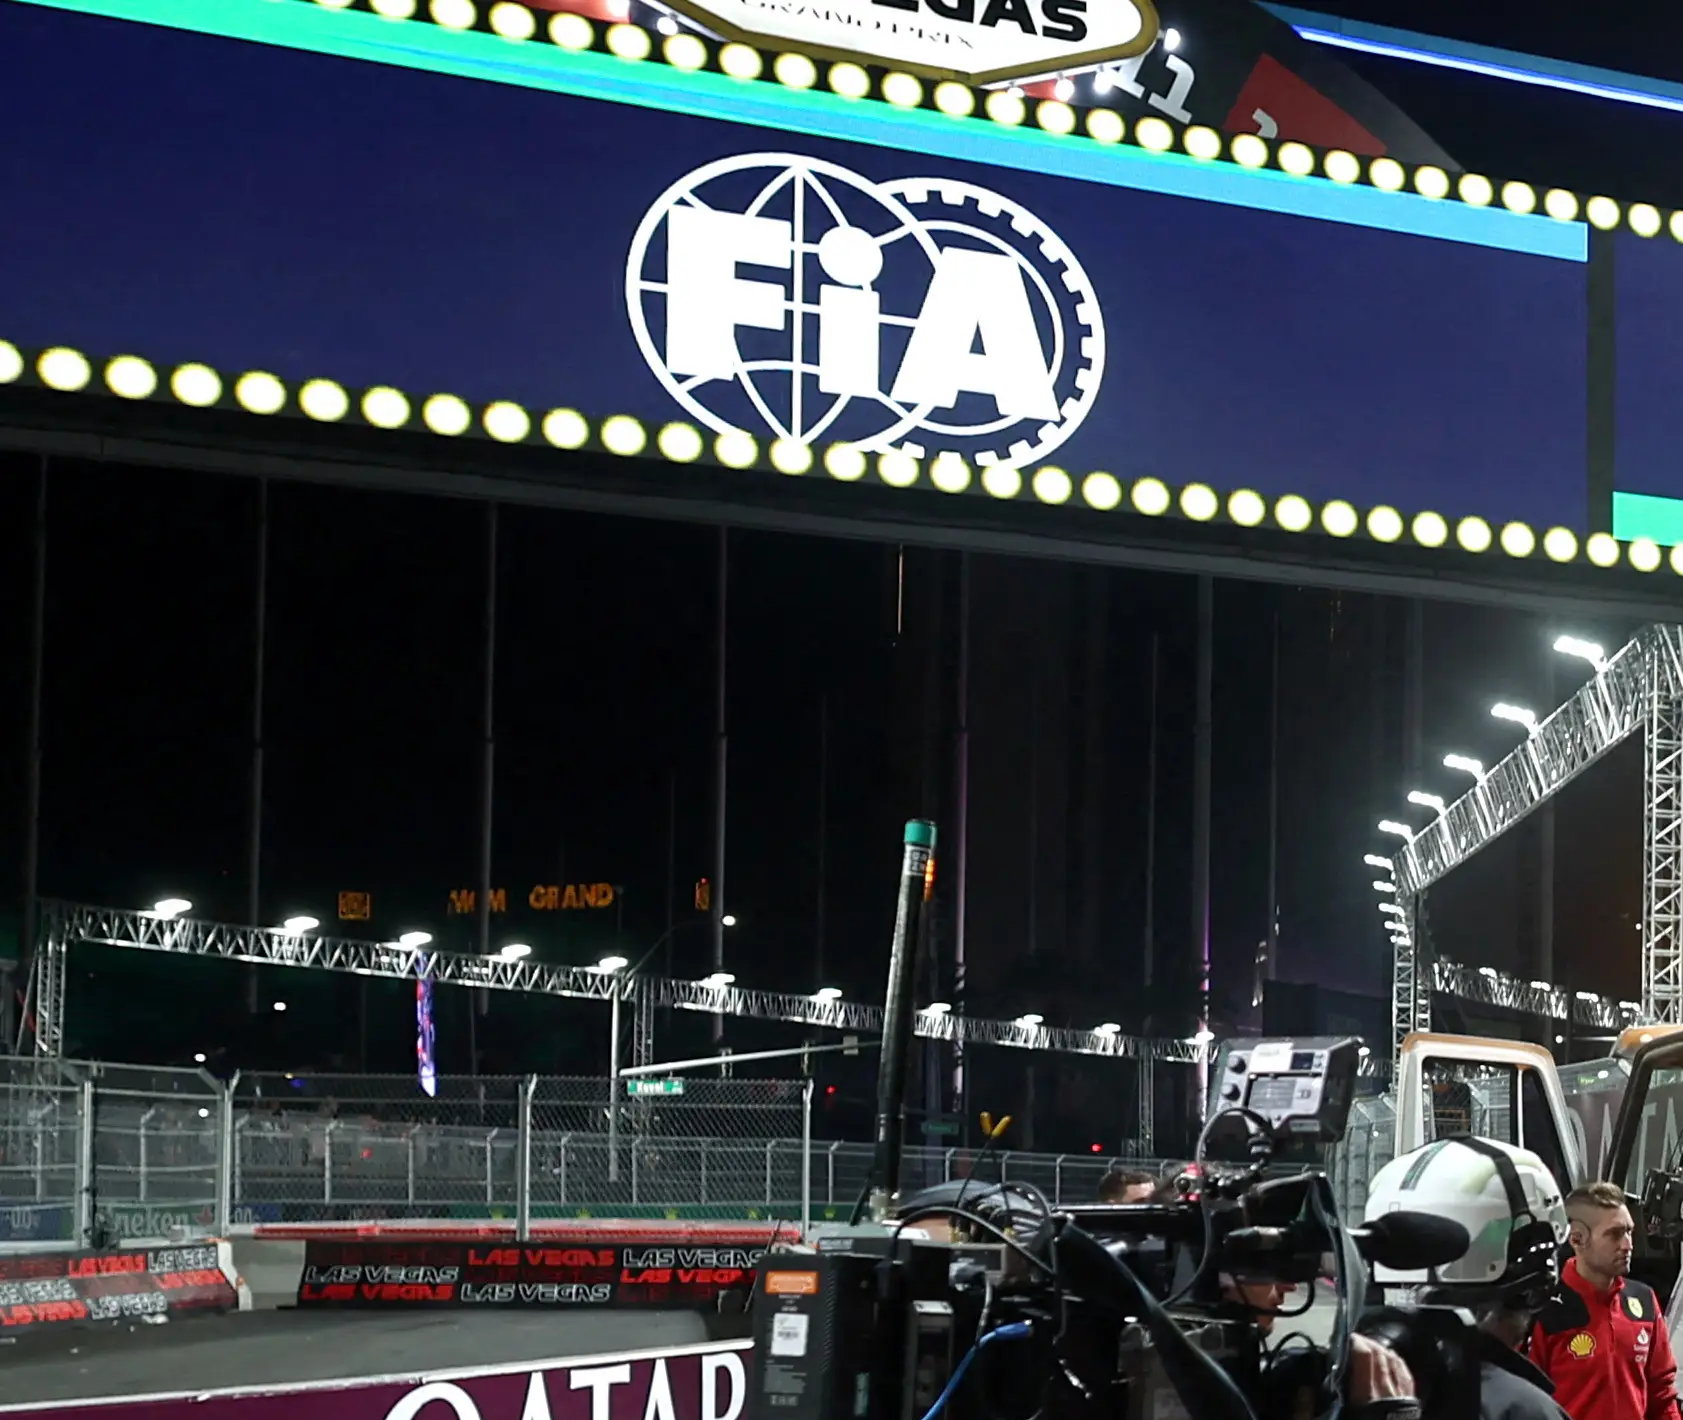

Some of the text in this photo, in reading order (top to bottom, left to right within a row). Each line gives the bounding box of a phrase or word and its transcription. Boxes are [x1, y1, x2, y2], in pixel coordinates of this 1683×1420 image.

[870, 0, 1087, 42] GAS
[467, 1248, 520, 1266] LAS
[524, 1248, 615, 1266] VEGAS
[622, 1248, 675, 1268] LAS
[305, 1265, 362, 1284] LAS
[364, 1265, 459, 1284] VEGAS
[620, 1268, 672, 1284] LAS
[300, 1283, 454, 1301] LAS VEGAS
[460, 1283, 518, 1302] LAS
[519, 1283, 612, 1302] VEGAS
